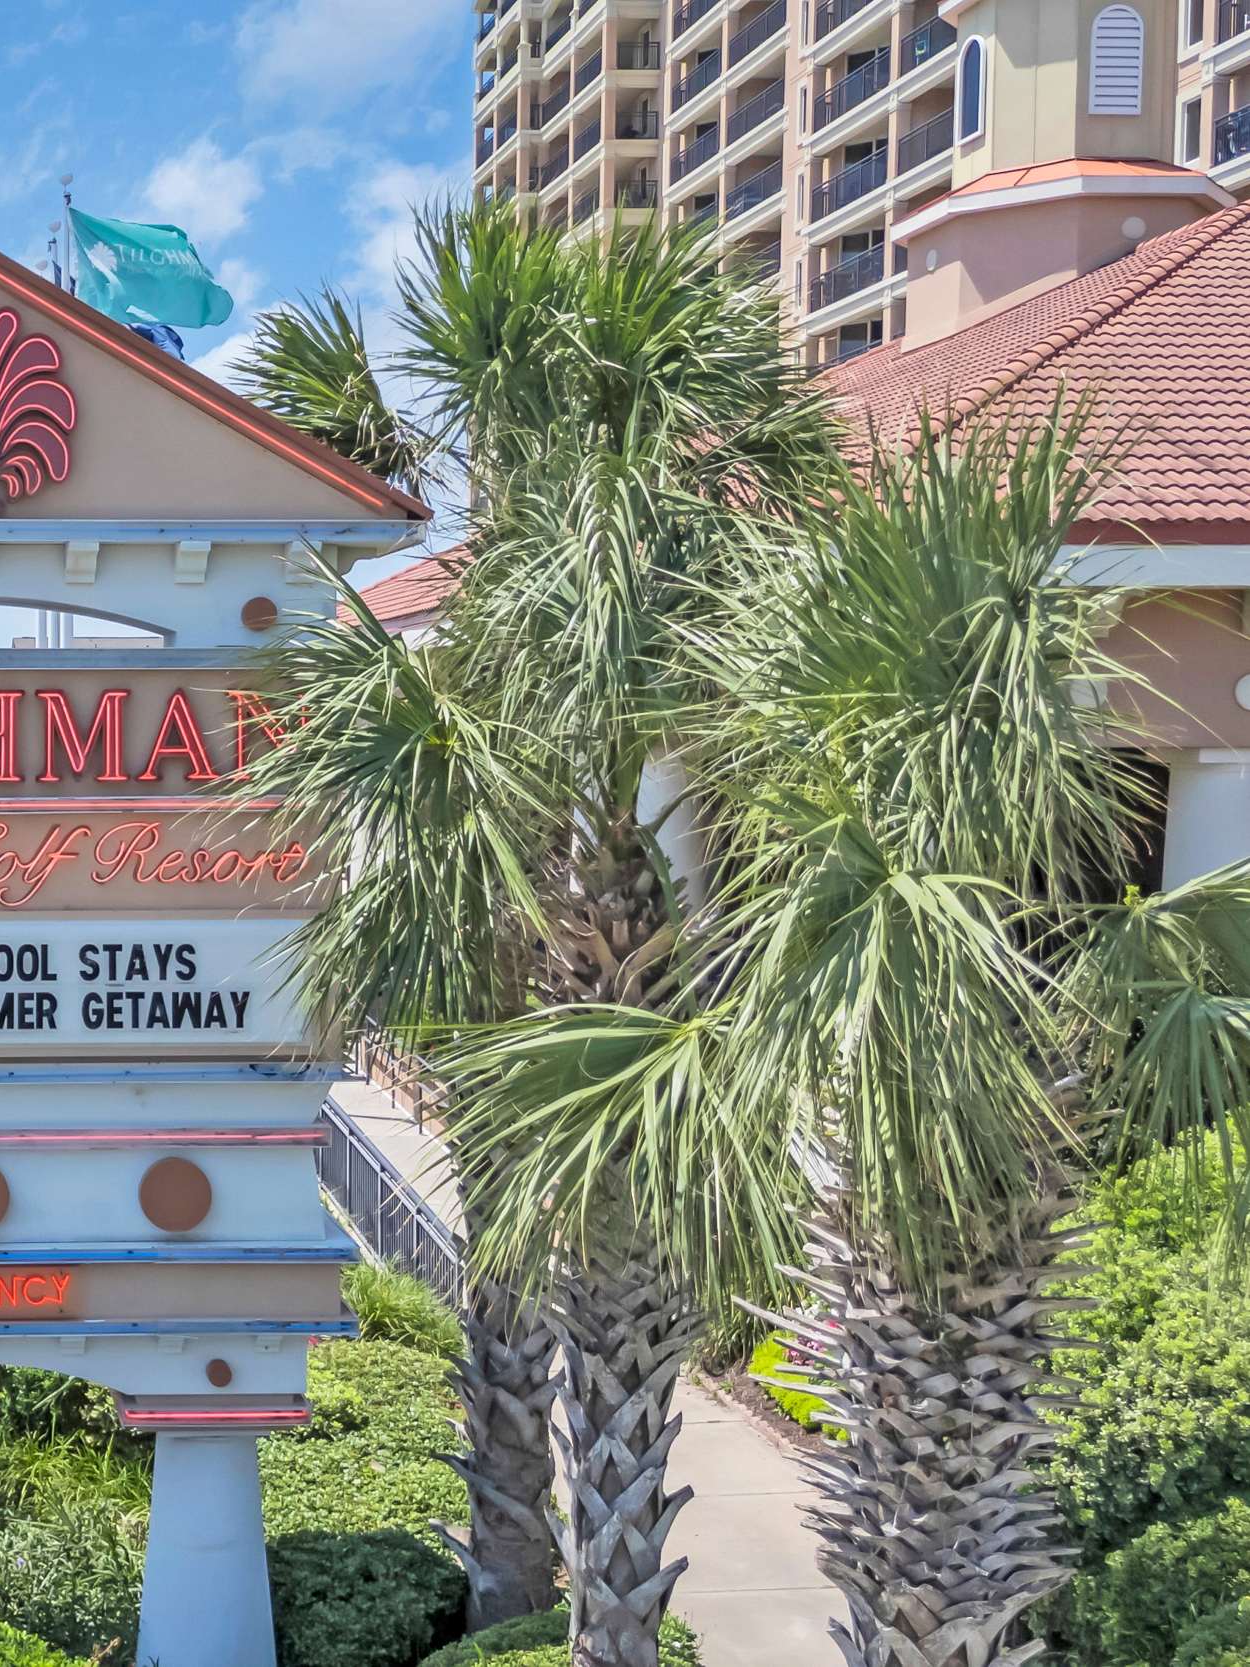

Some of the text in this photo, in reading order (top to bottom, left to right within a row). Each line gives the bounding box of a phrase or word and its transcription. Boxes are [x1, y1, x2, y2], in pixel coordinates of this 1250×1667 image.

[90, 821, 312, 884] Resort
[78, 943, 197, 982] STAYS
[81, 991, 251, 1030] GETAWAY
